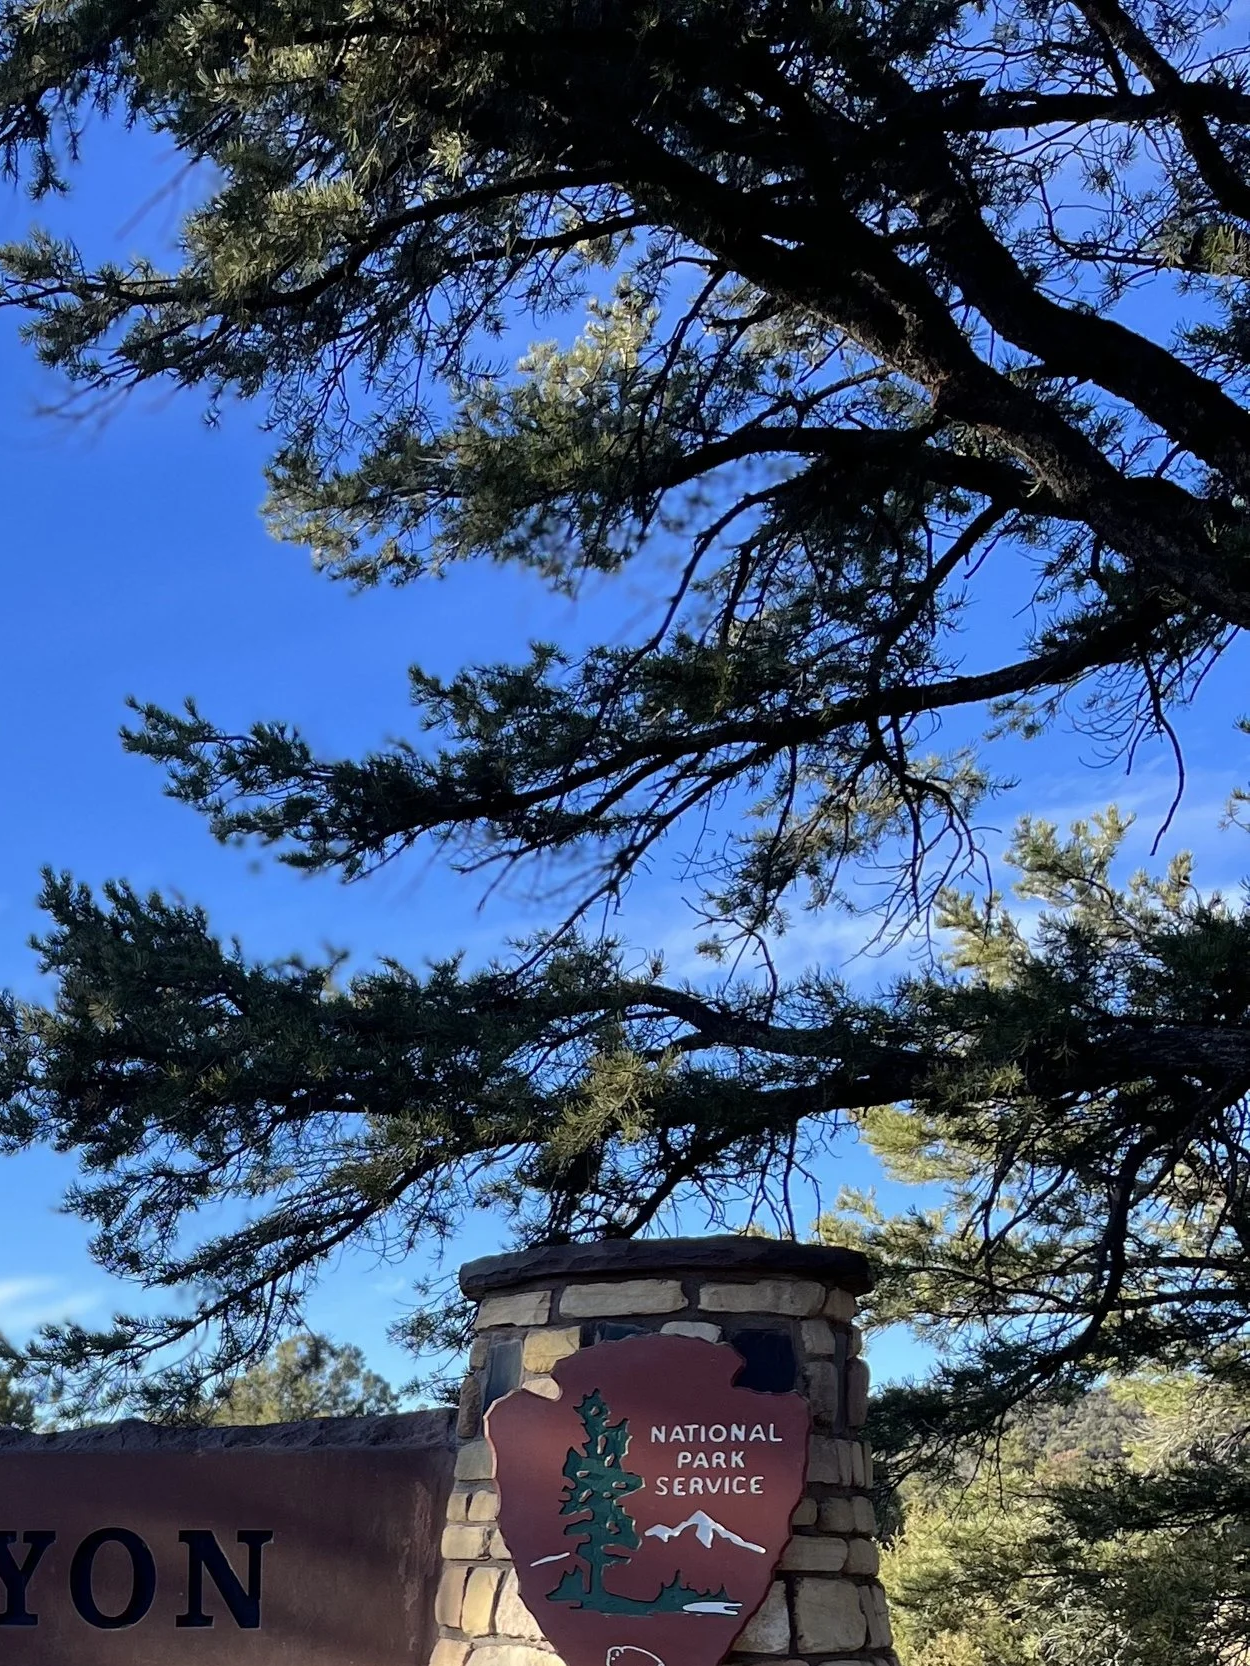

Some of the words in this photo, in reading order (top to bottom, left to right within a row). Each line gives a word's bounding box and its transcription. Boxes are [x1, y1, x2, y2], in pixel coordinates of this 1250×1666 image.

[651, 1424, 782, 1443] NATIONAL
[677, 1452, 745, 1468] PARK
[655, 1476, 764, 1495] SERVICE
